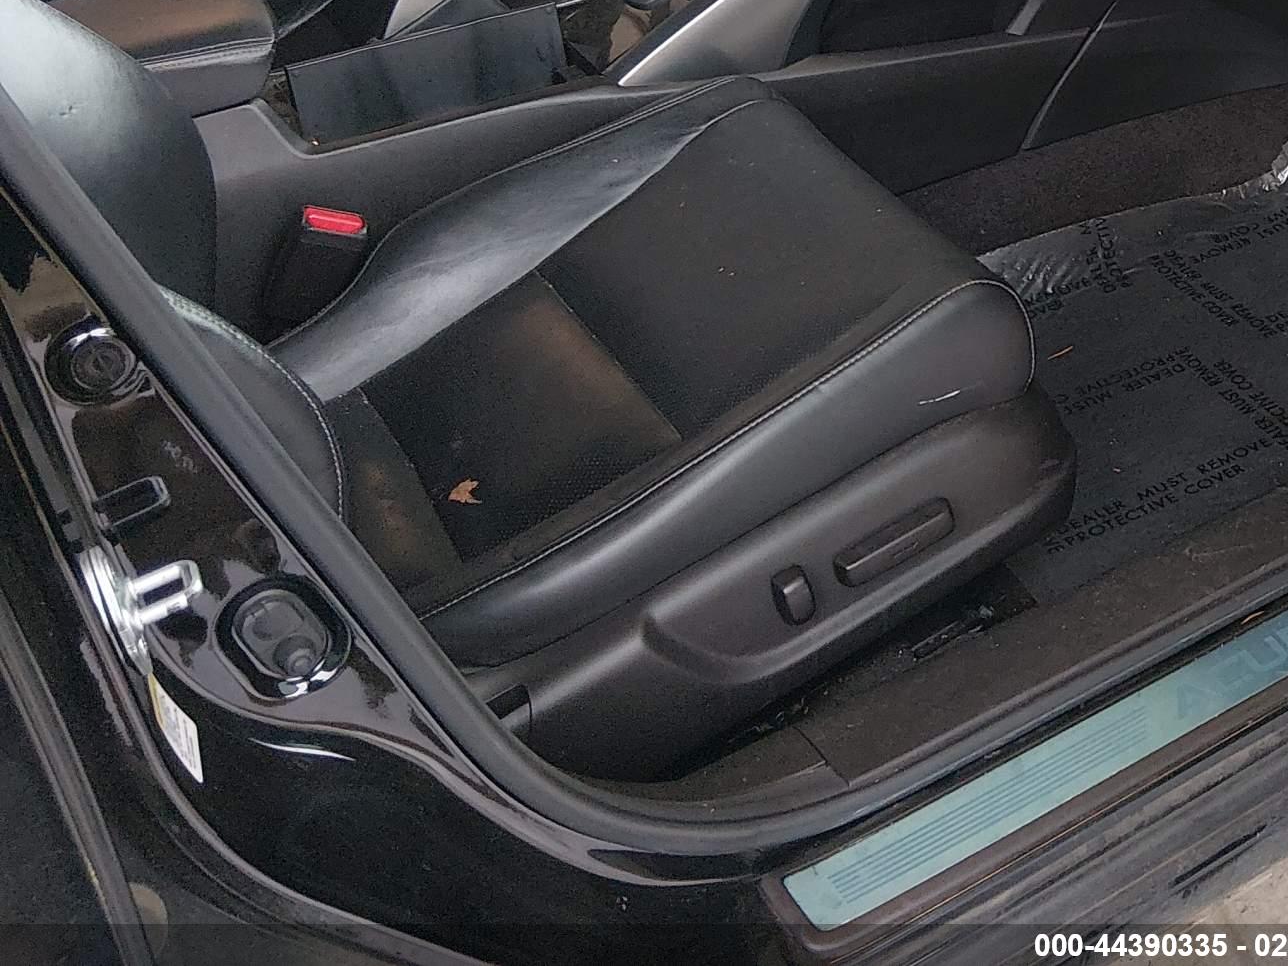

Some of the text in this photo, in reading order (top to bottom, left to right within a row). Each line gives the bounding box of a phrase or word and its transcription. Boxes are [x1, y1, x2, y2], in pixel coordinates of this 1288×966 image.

[1063, 491, 1180, 548] PROTECTIVE
[1183, 463, 1246, 495] COVER
[1136, 471, 1189, 502] MUST
[1195, 437, 1273, 475] REMOVE
